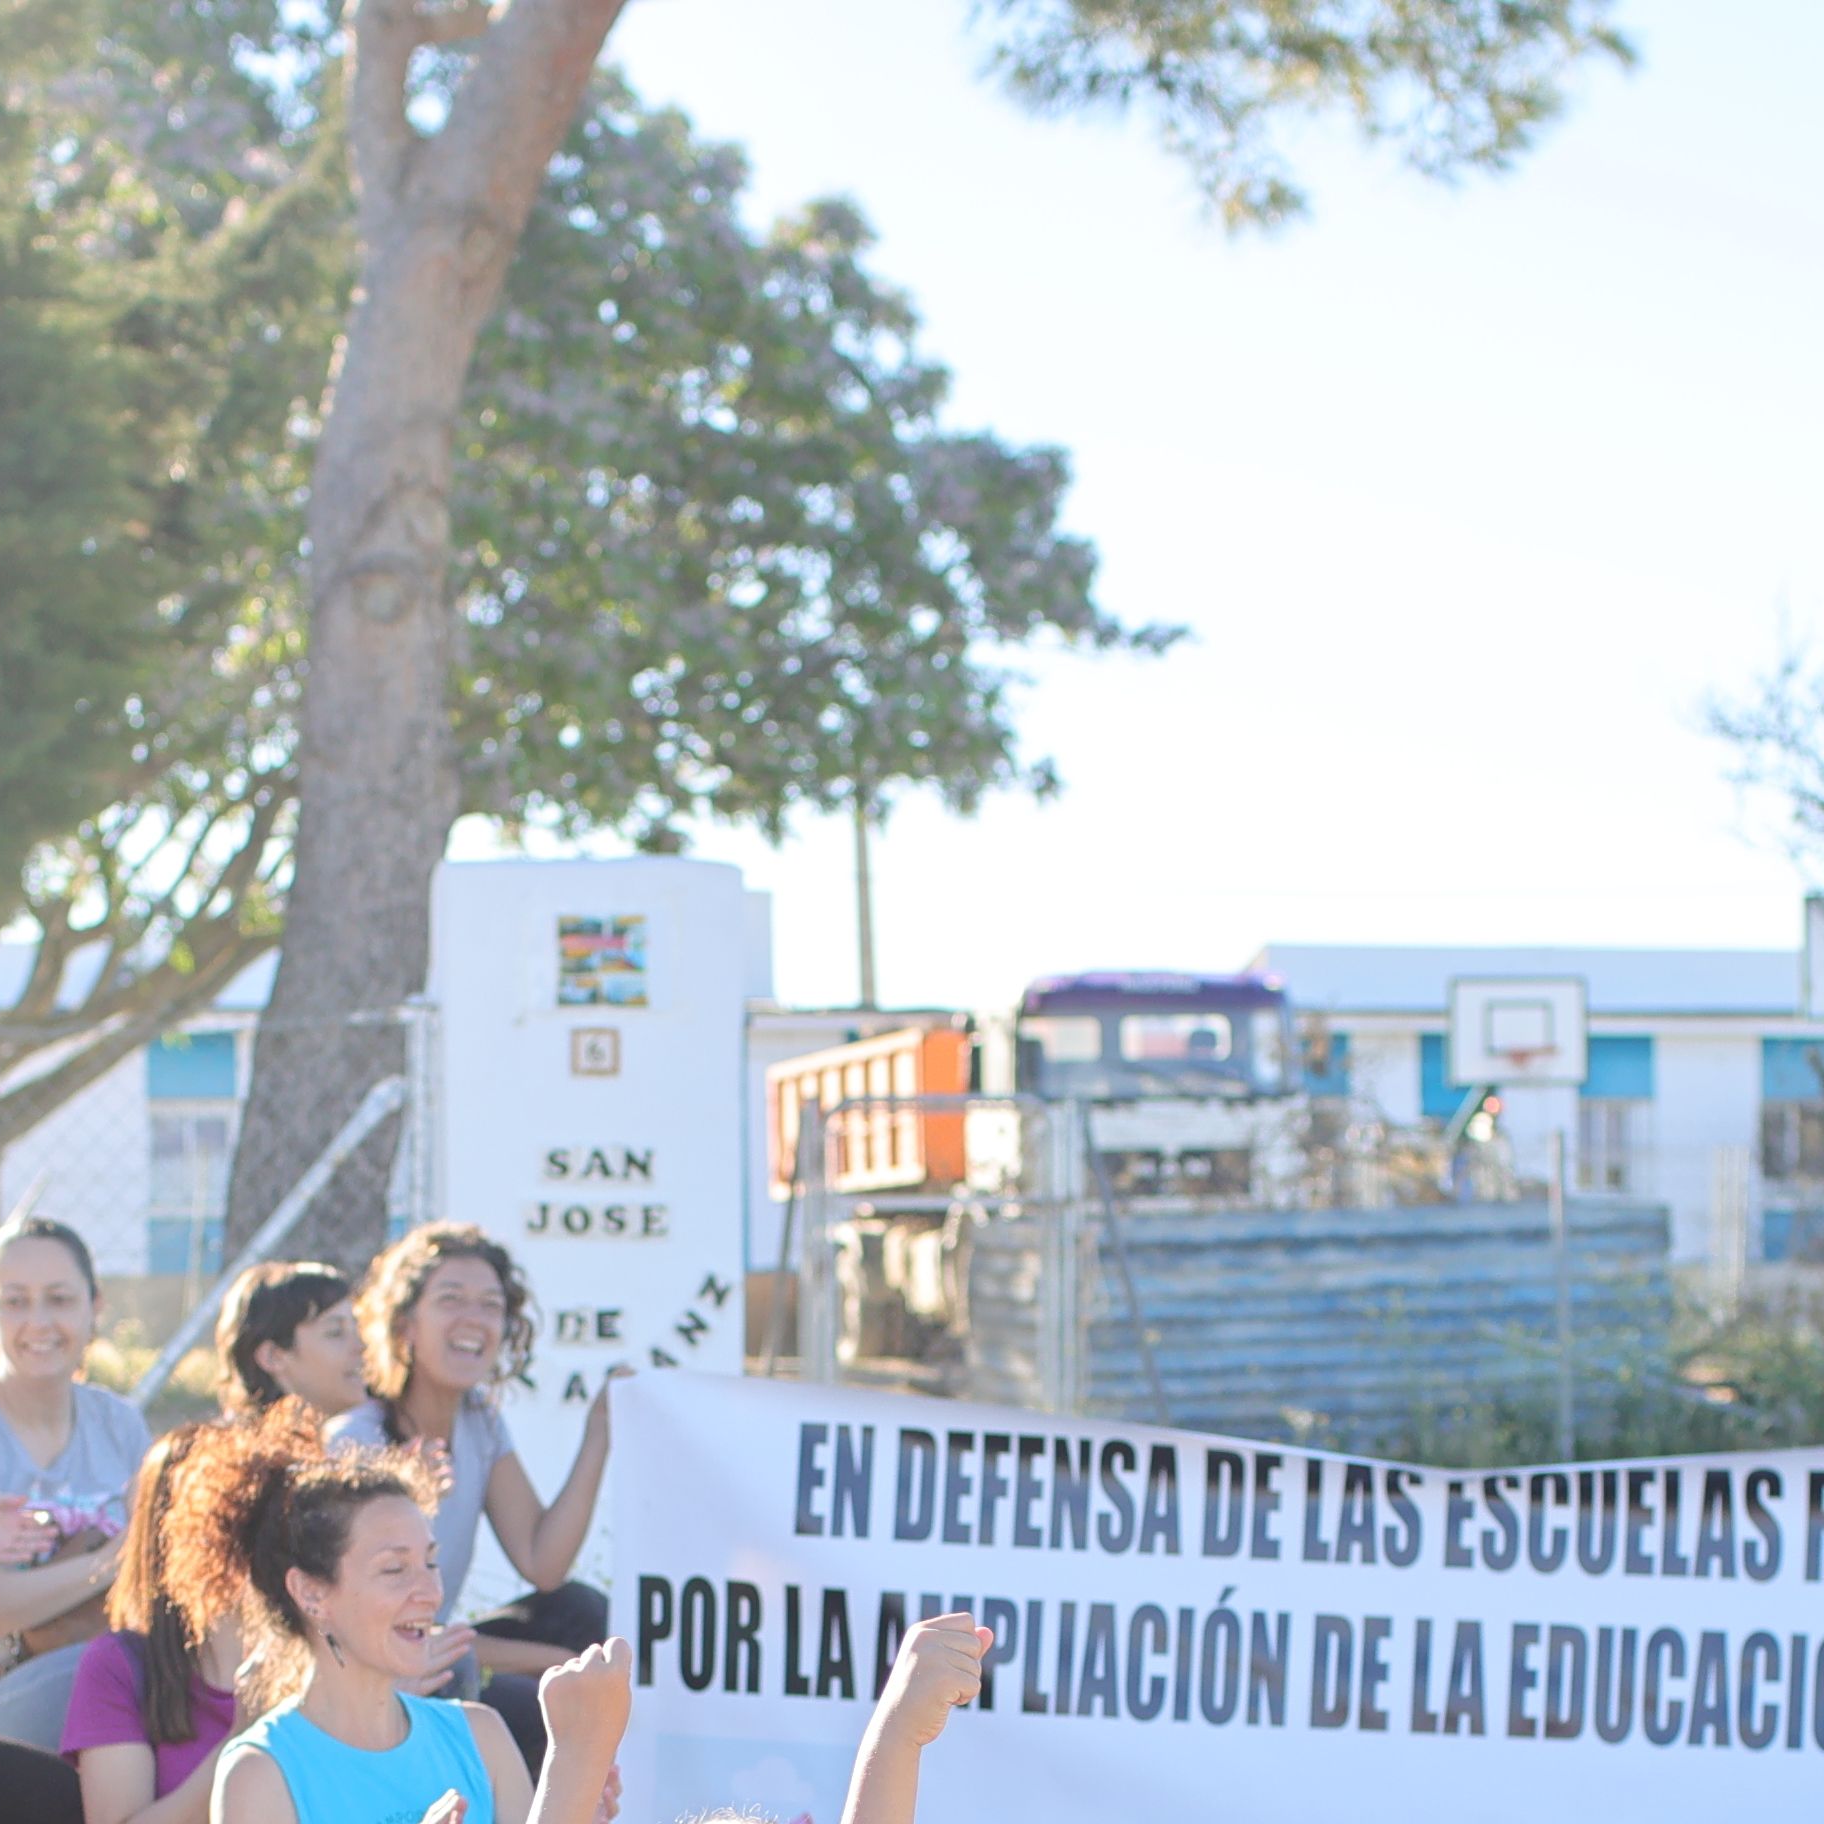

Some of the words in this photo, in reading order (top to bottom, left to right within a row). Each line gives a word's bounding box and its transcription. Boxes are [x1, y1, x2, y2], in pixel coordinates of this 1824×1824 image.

[545, 1147, 654, 1179] SAN
[527, 1201, 669, 1236] JOSE
[557, 1309, 622, 1341] DE
[794, 1422, 875, 1538] EN
[893, 1427, 1182, 1556] DEFENSA
[1202, 1448, 1284, 1560] DE
[1302, 1457, 1424, 1568] LAS
[1443, 1467, 1784, 1583] ESCUELAS
[637, 1575, 762, 1694] POR
[784, 1584, 856, 1700] LA
[872, 1586, 1291, 1728] APLIACIÓN
[1310, 1615, 1393, 1734] DE
[1410, 1616, 1485, 1737] LA
